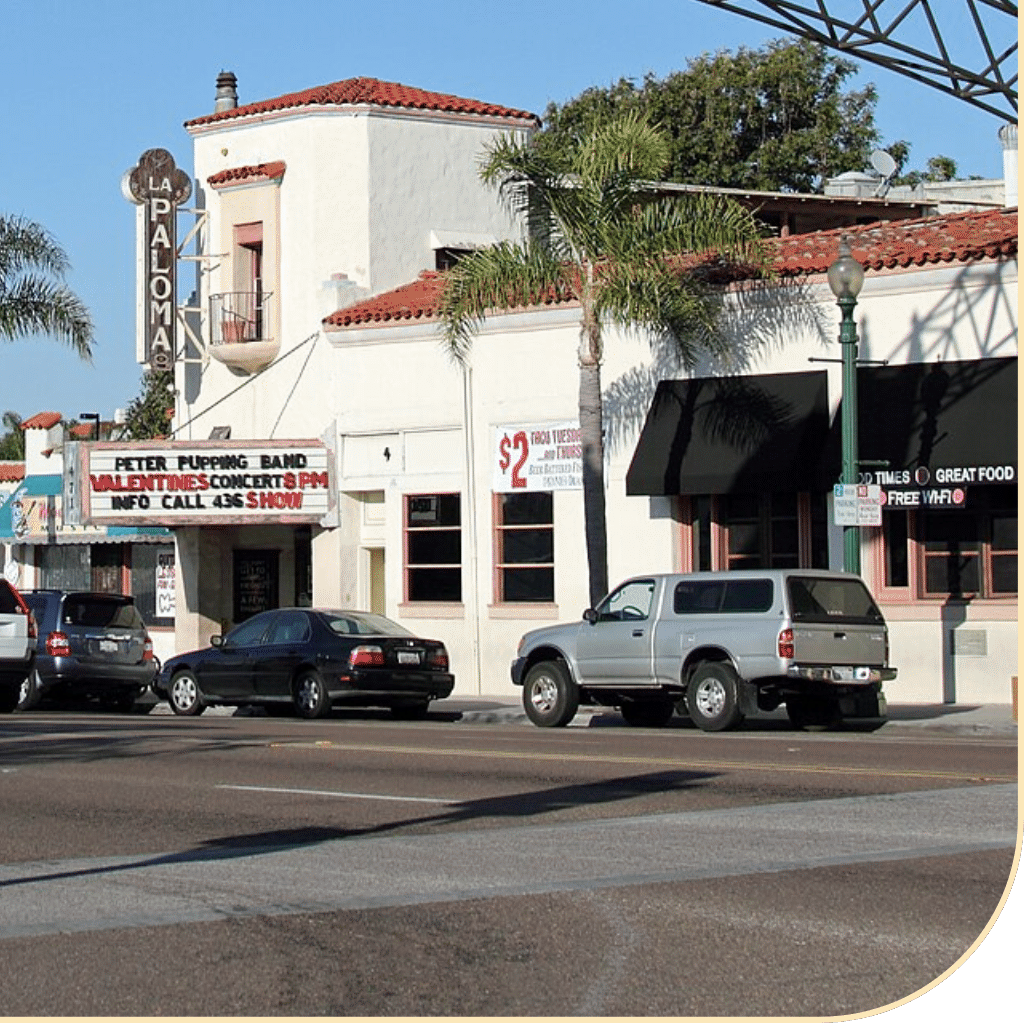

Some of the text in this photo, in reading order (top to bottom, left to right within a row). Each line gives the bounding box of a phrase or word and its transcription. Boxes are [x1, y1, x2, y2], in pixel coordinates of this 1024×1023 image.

[149, 176, 172, 192] LA
[150, 198, 171, 351] PALOMA
[115, 453, 307, 471] PETER PUPPING BAND
[499, 431, 529, 489] $2
[90, 473, 209, 492] VALENTINES
[210, 474, 284, 489] CONCERT
[875, 470, 910, 484] TIMES
[936, 467, 977, 483] GREAT
[978, 465, 1015, 481] FOOD
[112, 495, 150, 510] INFO
[162, 494, 206, 509] CALL
[888, 491, 920, 505] FREE
